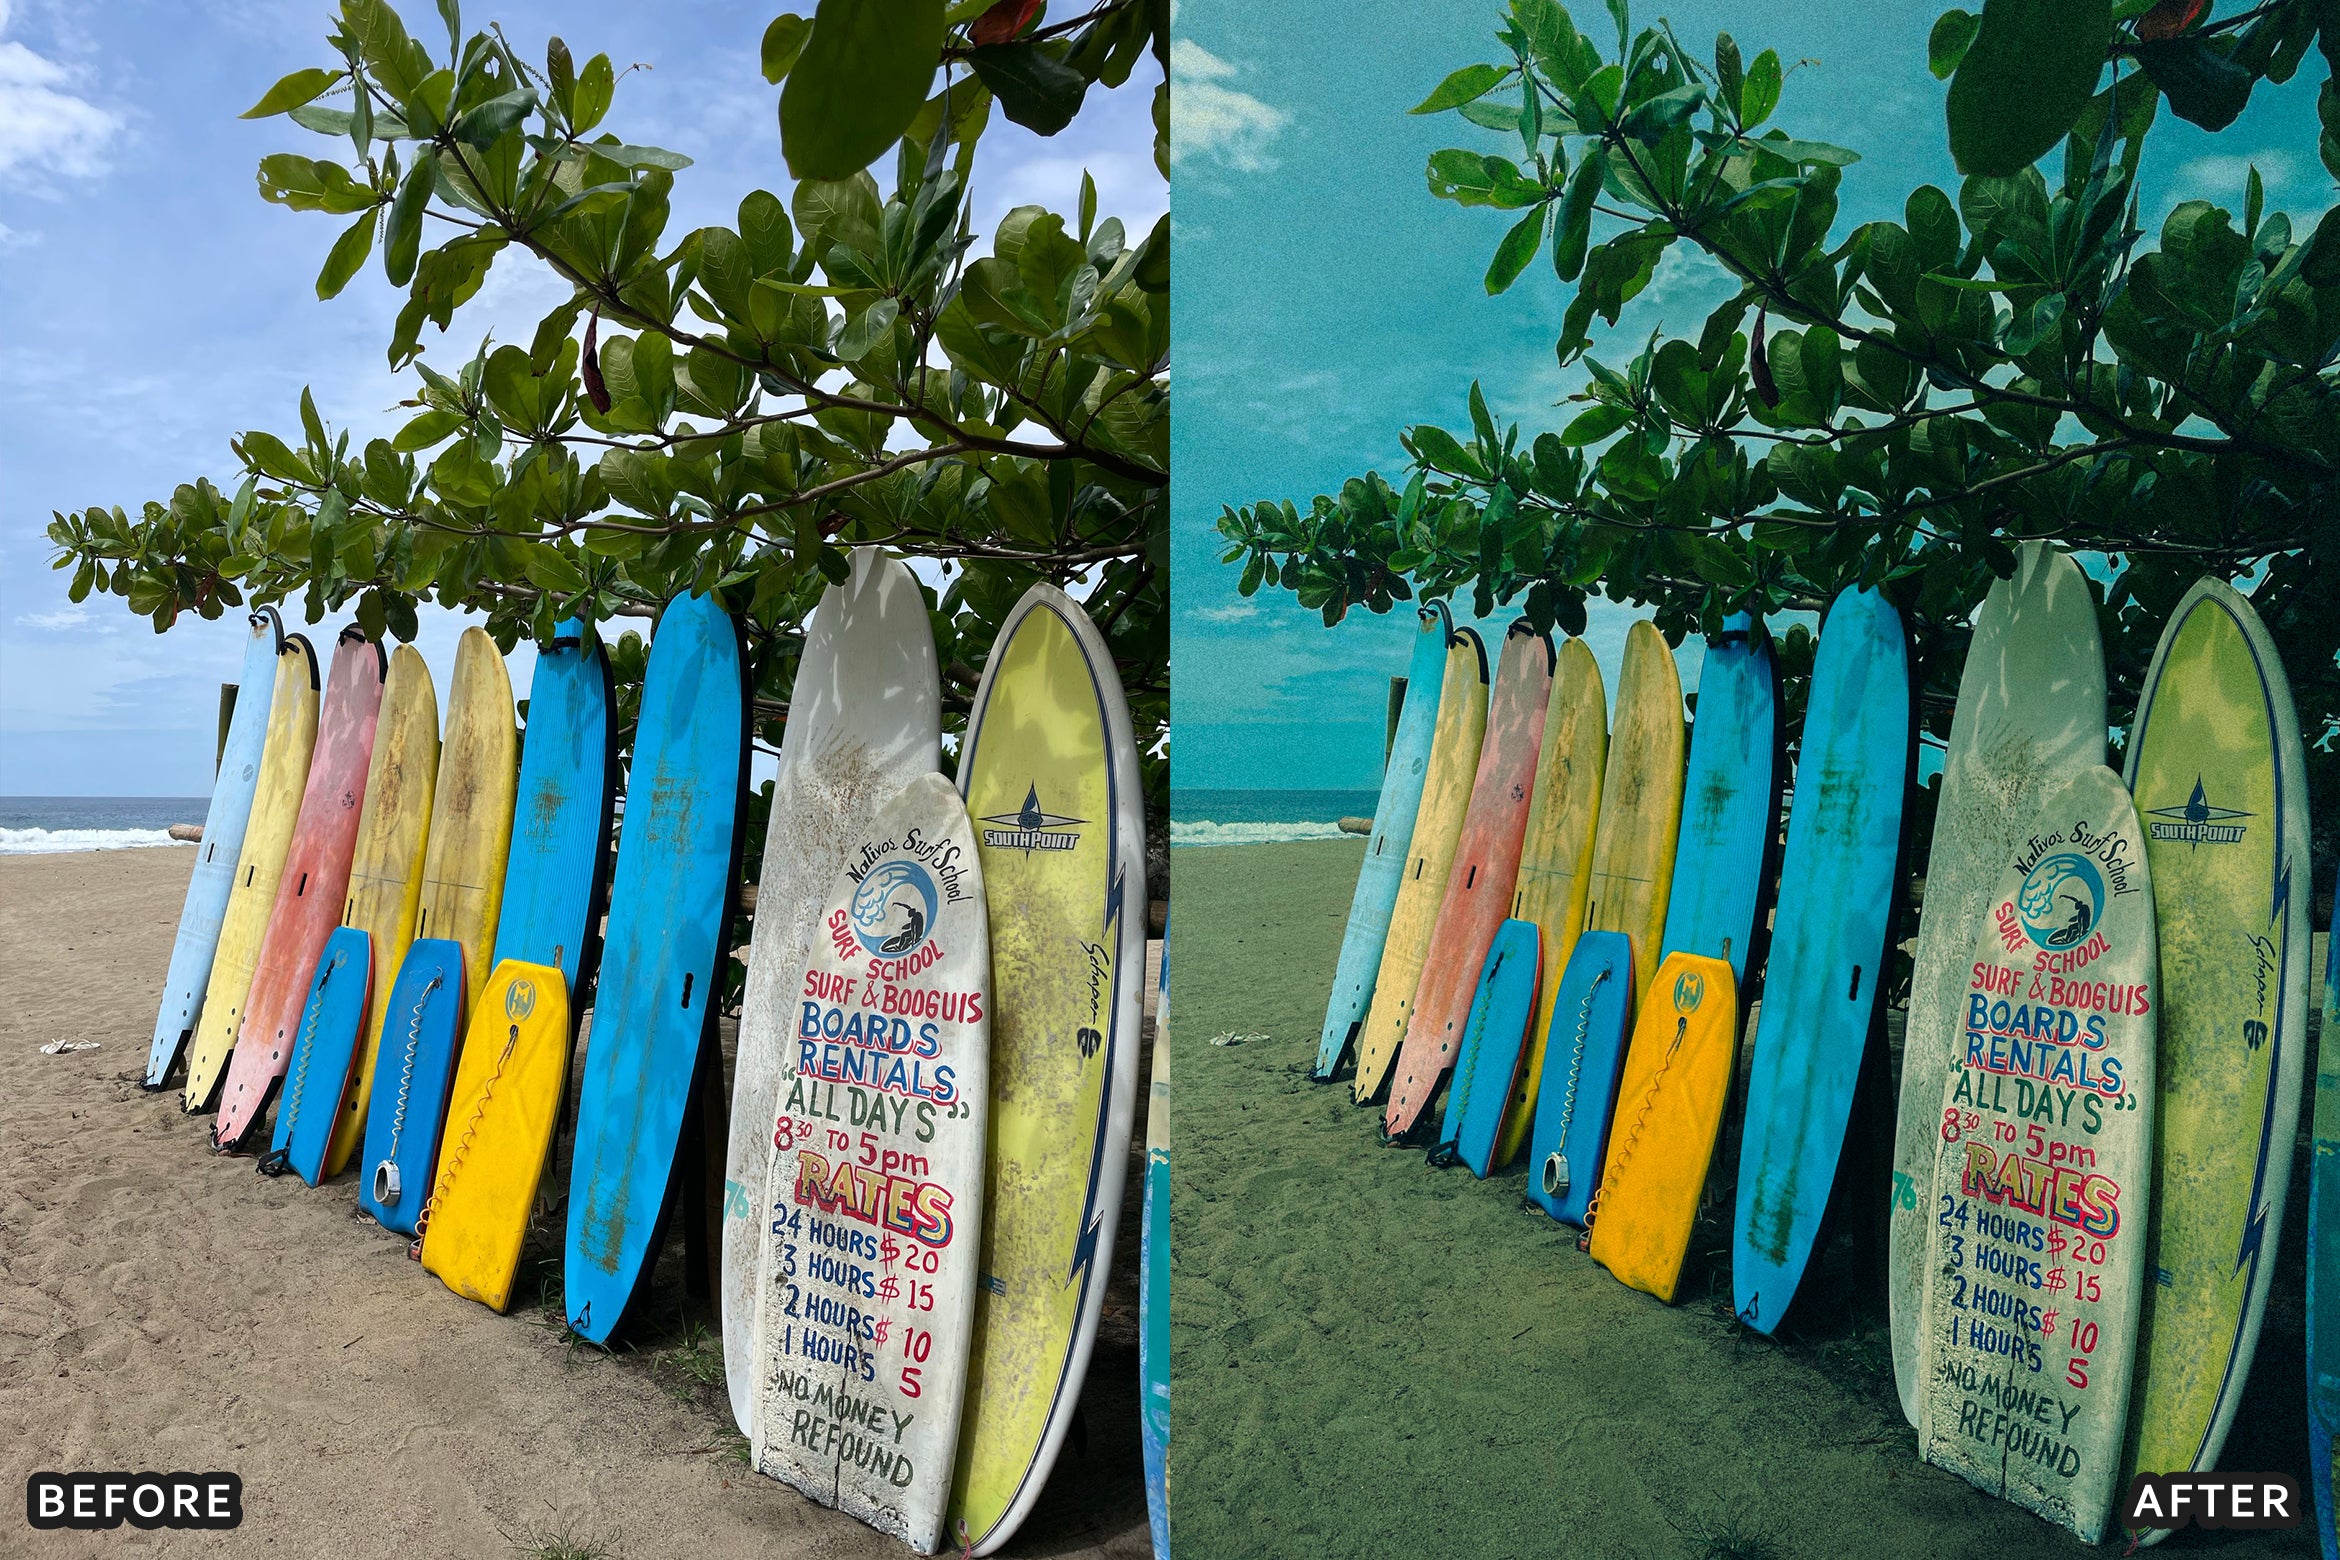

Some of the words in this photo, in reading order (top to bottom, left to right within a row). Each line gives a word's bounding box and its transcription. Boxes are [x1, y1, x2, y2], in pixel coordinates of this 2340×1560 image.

[846, 838, 899, 884] Nativos
[903, 828, 951, 862] Surf
[932, 846, 974, 905] School
[2013, 831, 2065, 876] Nativos
[2069, 821, 2118, 855] Surf
[2099, 838, 2140, 898] School
[828, 909, 862, 961] SURF
[865, 940, 945, 981] SCHOOL
[1995, 901, 2029, 953] SURF
[2032, 932, 2111, 974] SCHOOL
[803, 970, 857, 1004] SURF
[861, 980, 880, 1009] &
[881, 985, 984, 1024] BOOGUIS
[1966, 993, 2109, 1050] BOARDS
[1971, 962, 2024, 997] SURF
[2028, 973, 2047, 1001] &
[2048, 977, 2150, 1016] BOOGUIS
[799, 1001, 942, 1059] BOARDS
[797, 1040, 960, 1105] RENTALS
[1963, 1032, 2126, 1098] RENTALS
[826, 1129, 850, 1151] TO
[1993, 1120, 2016, 1143] TO
[794, 1150, 955, 1248] RATES
[1939, 1194, 1969, 1231] 24
[1976, 1208, 2044, 1252] HOURS
[1962, 1141, 2121, 1240] RATES
[772, 1202, 802, 1239] 24
[809, 1217, 877, 1260] HOURS
[1950, 1235, 1964, 1268] 3
[1975, 1243, 2043, 1290] HOURS
[783, 1244, 797, 1277] 3
[808, 1252, 876, 1298] HOURS
[1951, 1275, 1968, 1311] 2
[1971, 1283, 2042, 1332] HOURS
[784, 1284, 801, 1320] 2
[804, 1292, 875, 1340] HOURS
[785, 1324, 791, 1355] 1
[802, 1327, 876, 1382] HOURS
[899, 1367, 922, 1399] 5
[1952, 1315, 1959, 1346] 1
[1969, 1315, 2042, 1373] HOURS
[2066, 1357, 2089, 1389] 5
[777, 1370, 810, 1400] NO
[811, 1381, 914, 1444] MONEY
[1945, 1361, 1977, 1391] NO
[1978, 1373, 2081, 1435] MONEY
[790, 1409, 914, 1487] REFOUND
[1957, 1400, 2081, 1478] REFOUND
